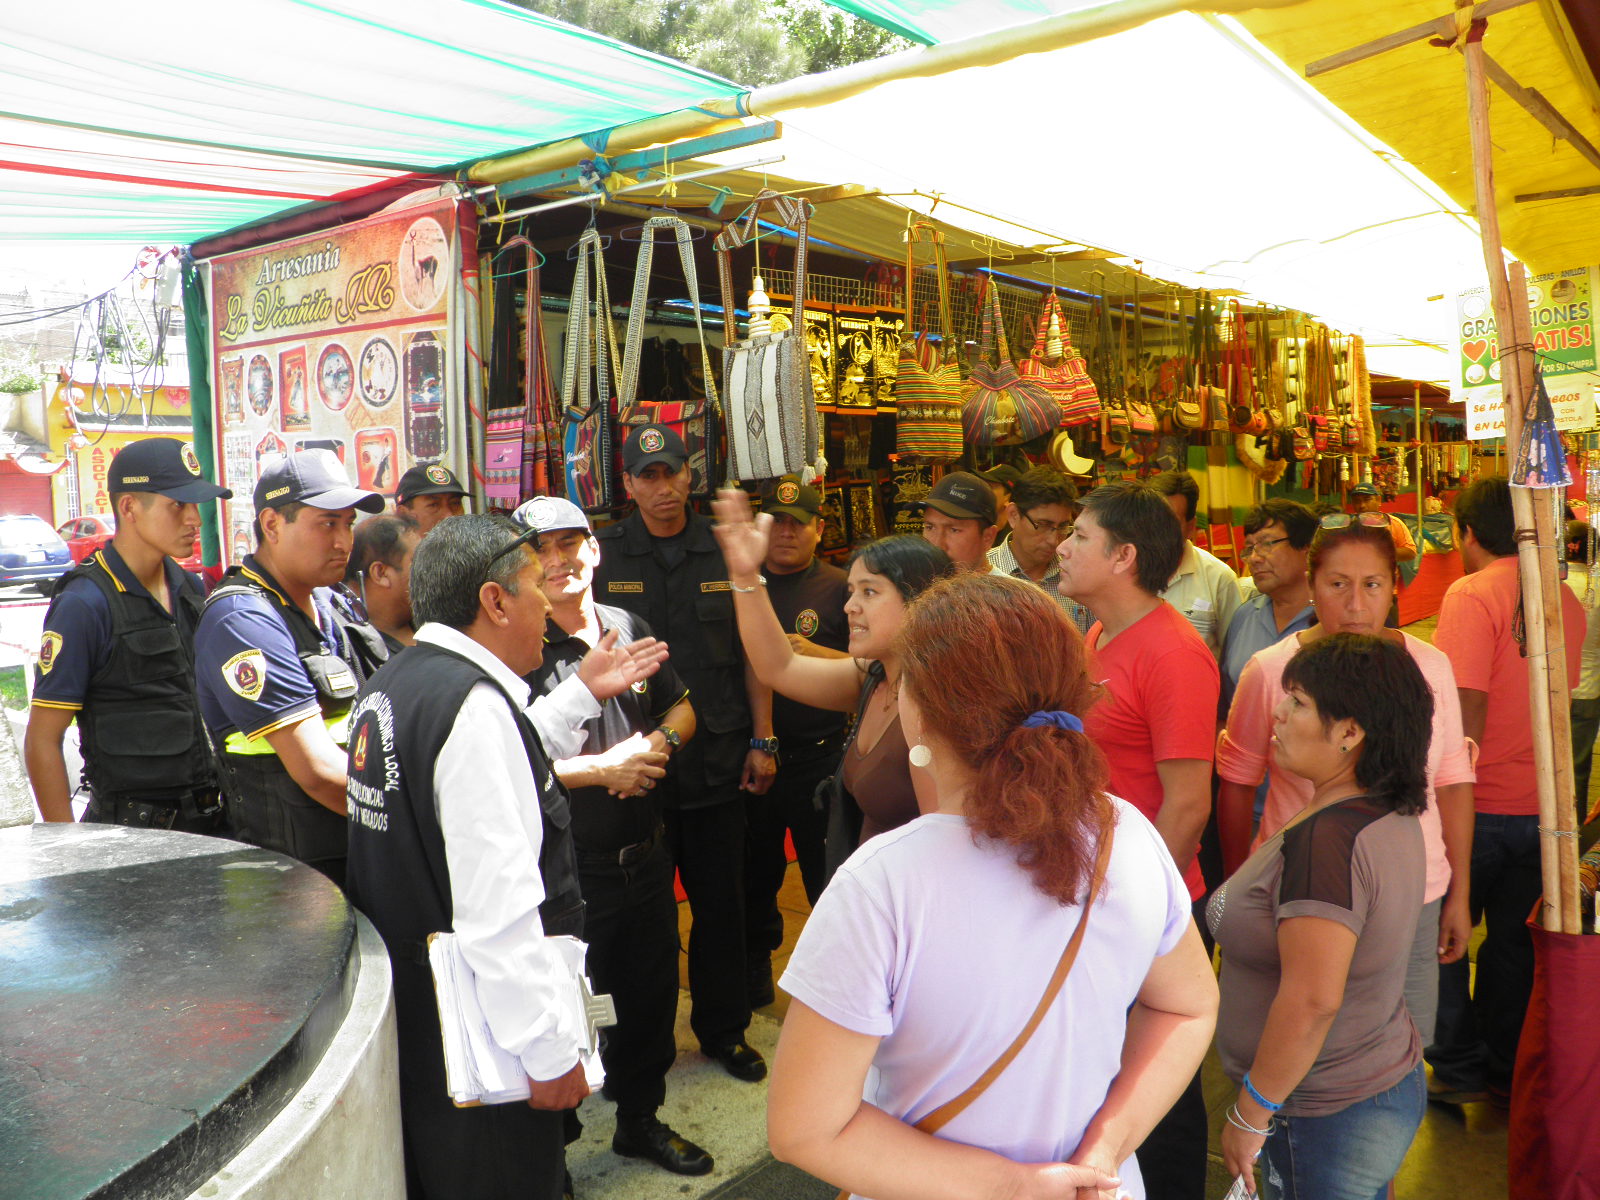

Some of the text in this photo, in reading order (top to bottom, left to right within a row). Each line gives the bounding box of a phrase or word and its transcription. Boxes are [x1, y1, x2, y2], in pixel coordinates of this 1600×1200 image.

[256, 242, 341, 286] Artesania
[219, 295, 248, 341] La
[252, 285, 333, 331] Vicuñita
[1556, 363, 1566, 371] SU
[265, 485, 291, 501] SERENAZGO
[384, 754, 400, 792] LOCAL
